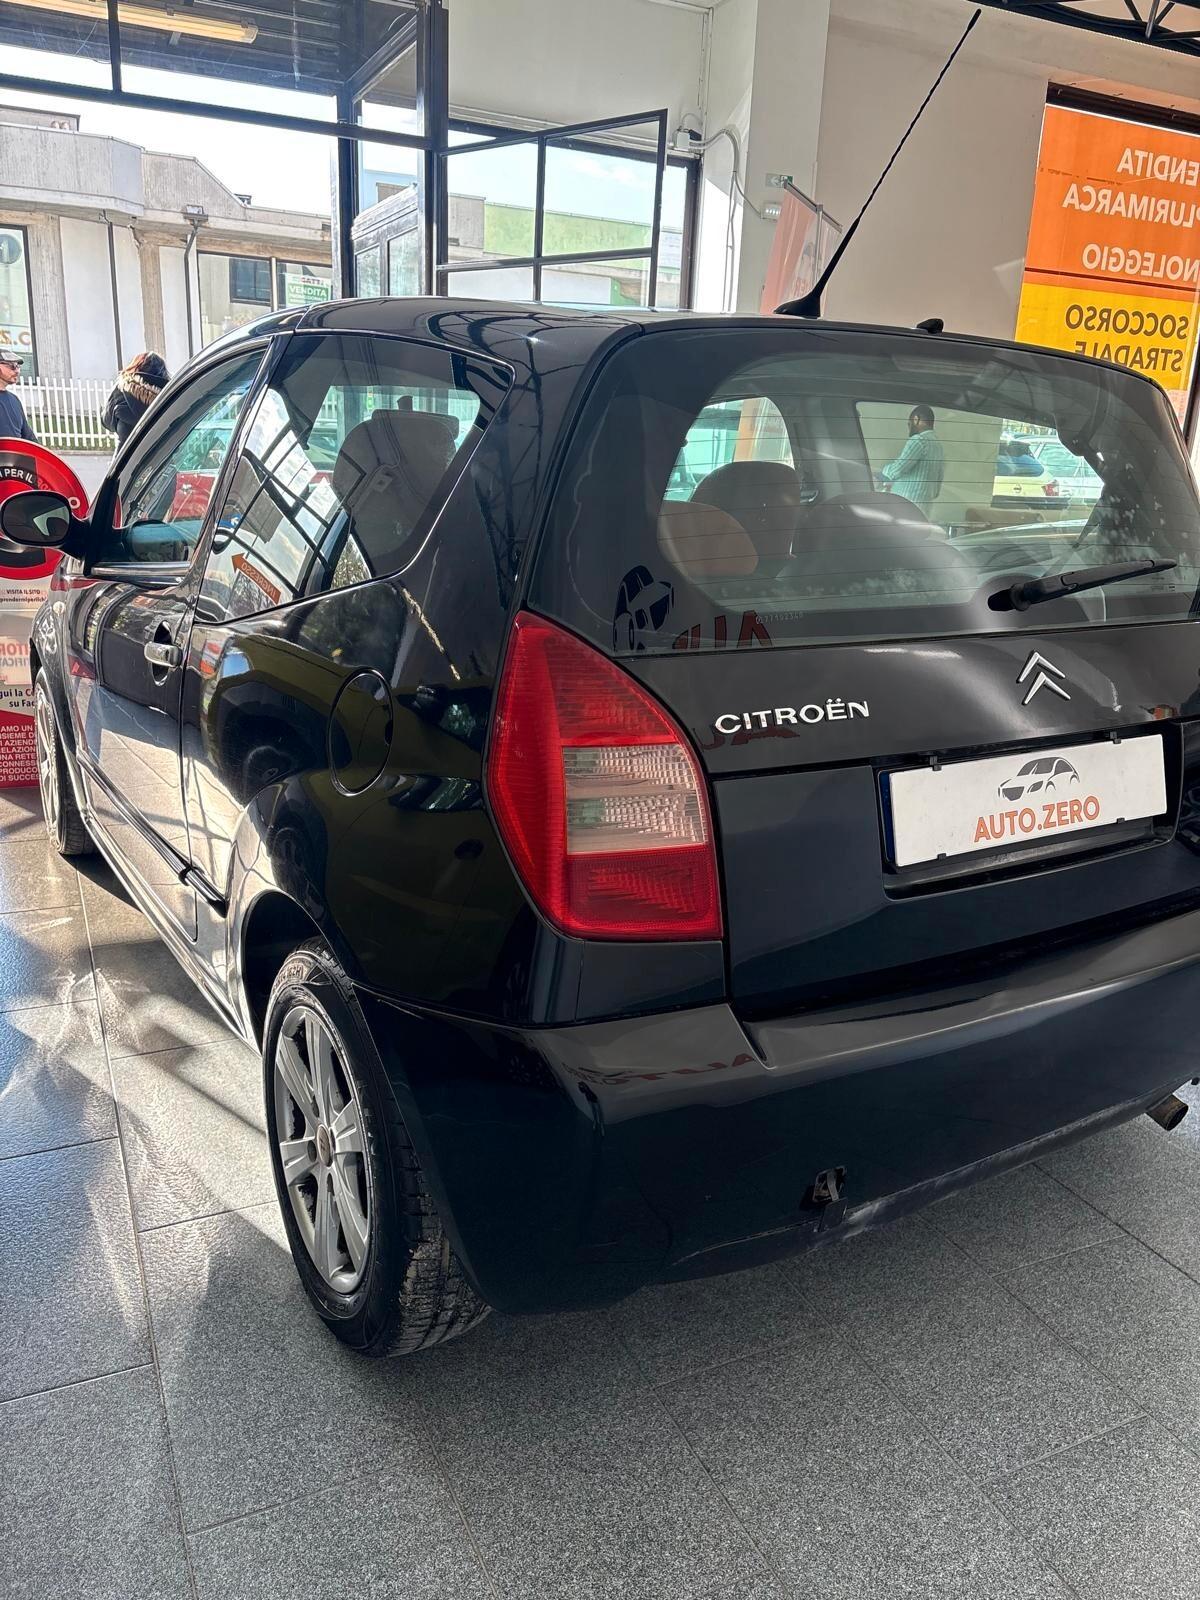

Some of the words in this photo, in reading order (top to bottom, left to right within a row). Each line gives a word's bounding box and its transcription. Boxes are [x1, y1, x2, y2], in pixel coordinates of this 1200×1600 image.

[289, 285, 327, 299] VENDITA
[4, 467, 24, 479] PER
[25, 474, 33, 484] IL
[14, 688, 23, 697] la
[9, 700, 19, 708] su
[714, 697, 870, 735] CITROËN
[974, 795, 1100, 843] AUTO.ZERO
